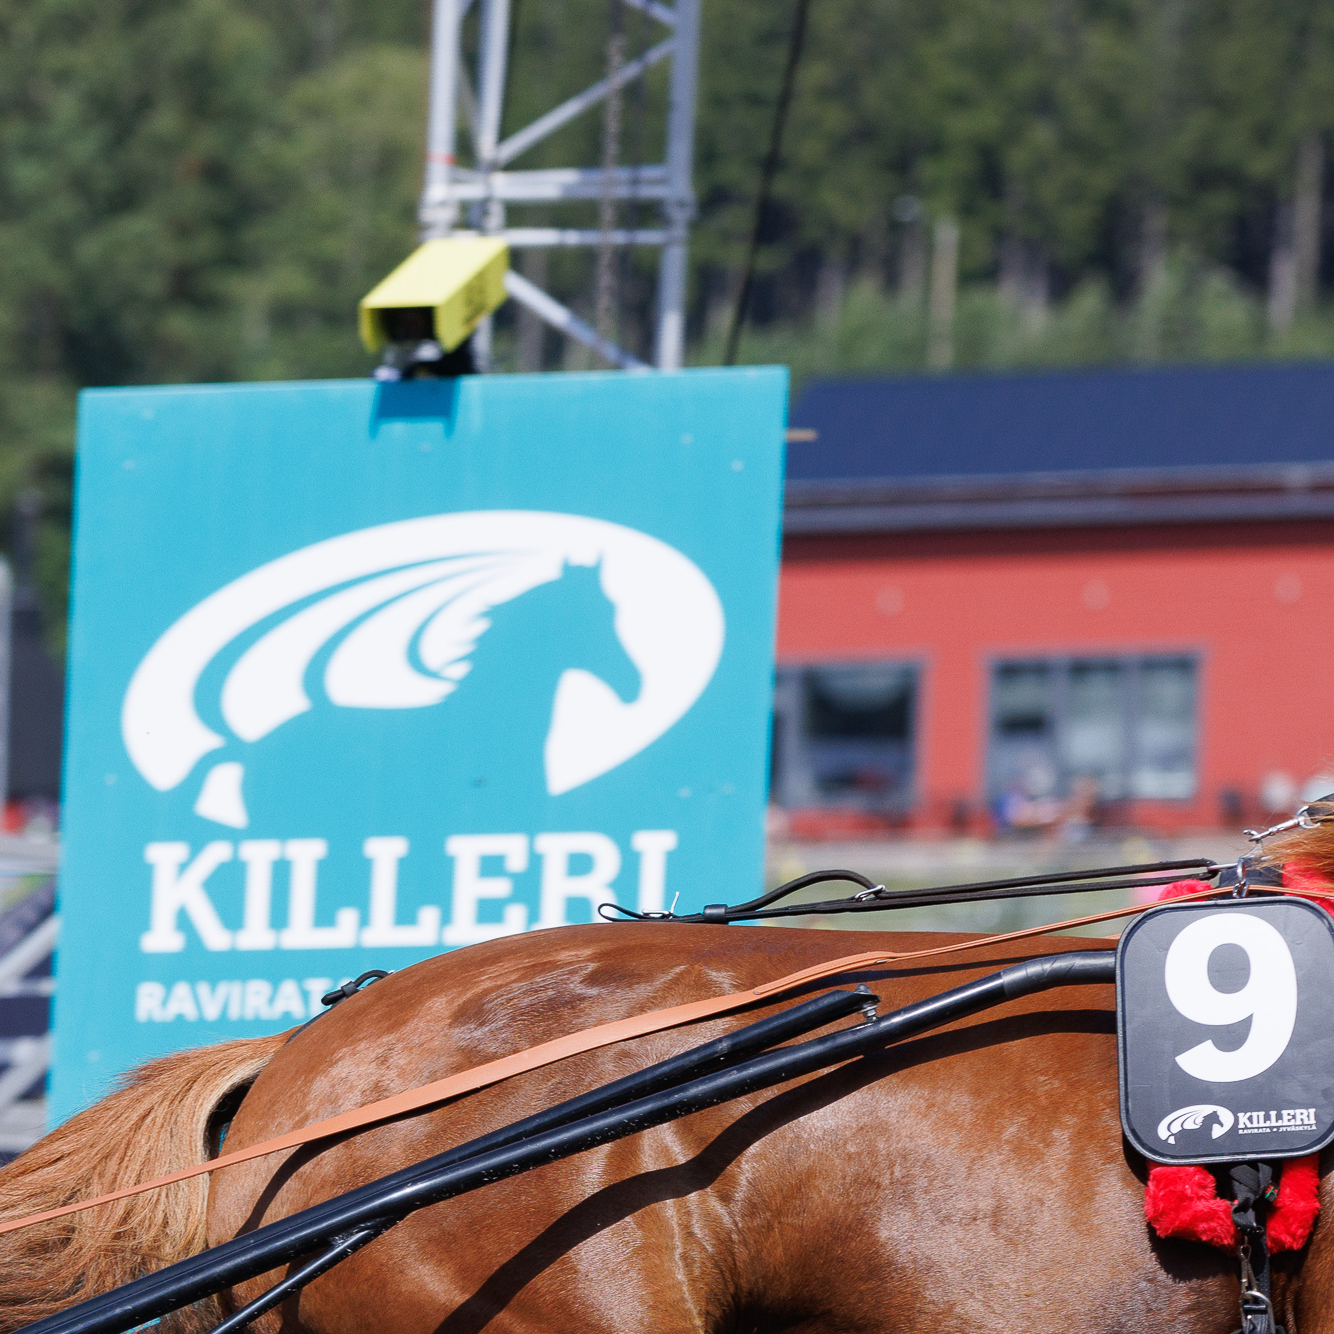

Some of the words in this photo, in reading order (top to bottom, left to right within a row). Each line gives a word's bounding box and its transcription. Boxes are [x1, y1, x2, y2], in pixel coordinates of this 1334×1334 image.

[140, 830, 678, 953] KILLERI
[135, 978, 359, 1023] RAVIRAT
[1164, 912, 1298, 1082] 9
[1237, 1108, 1317, 1129] KILLERI
